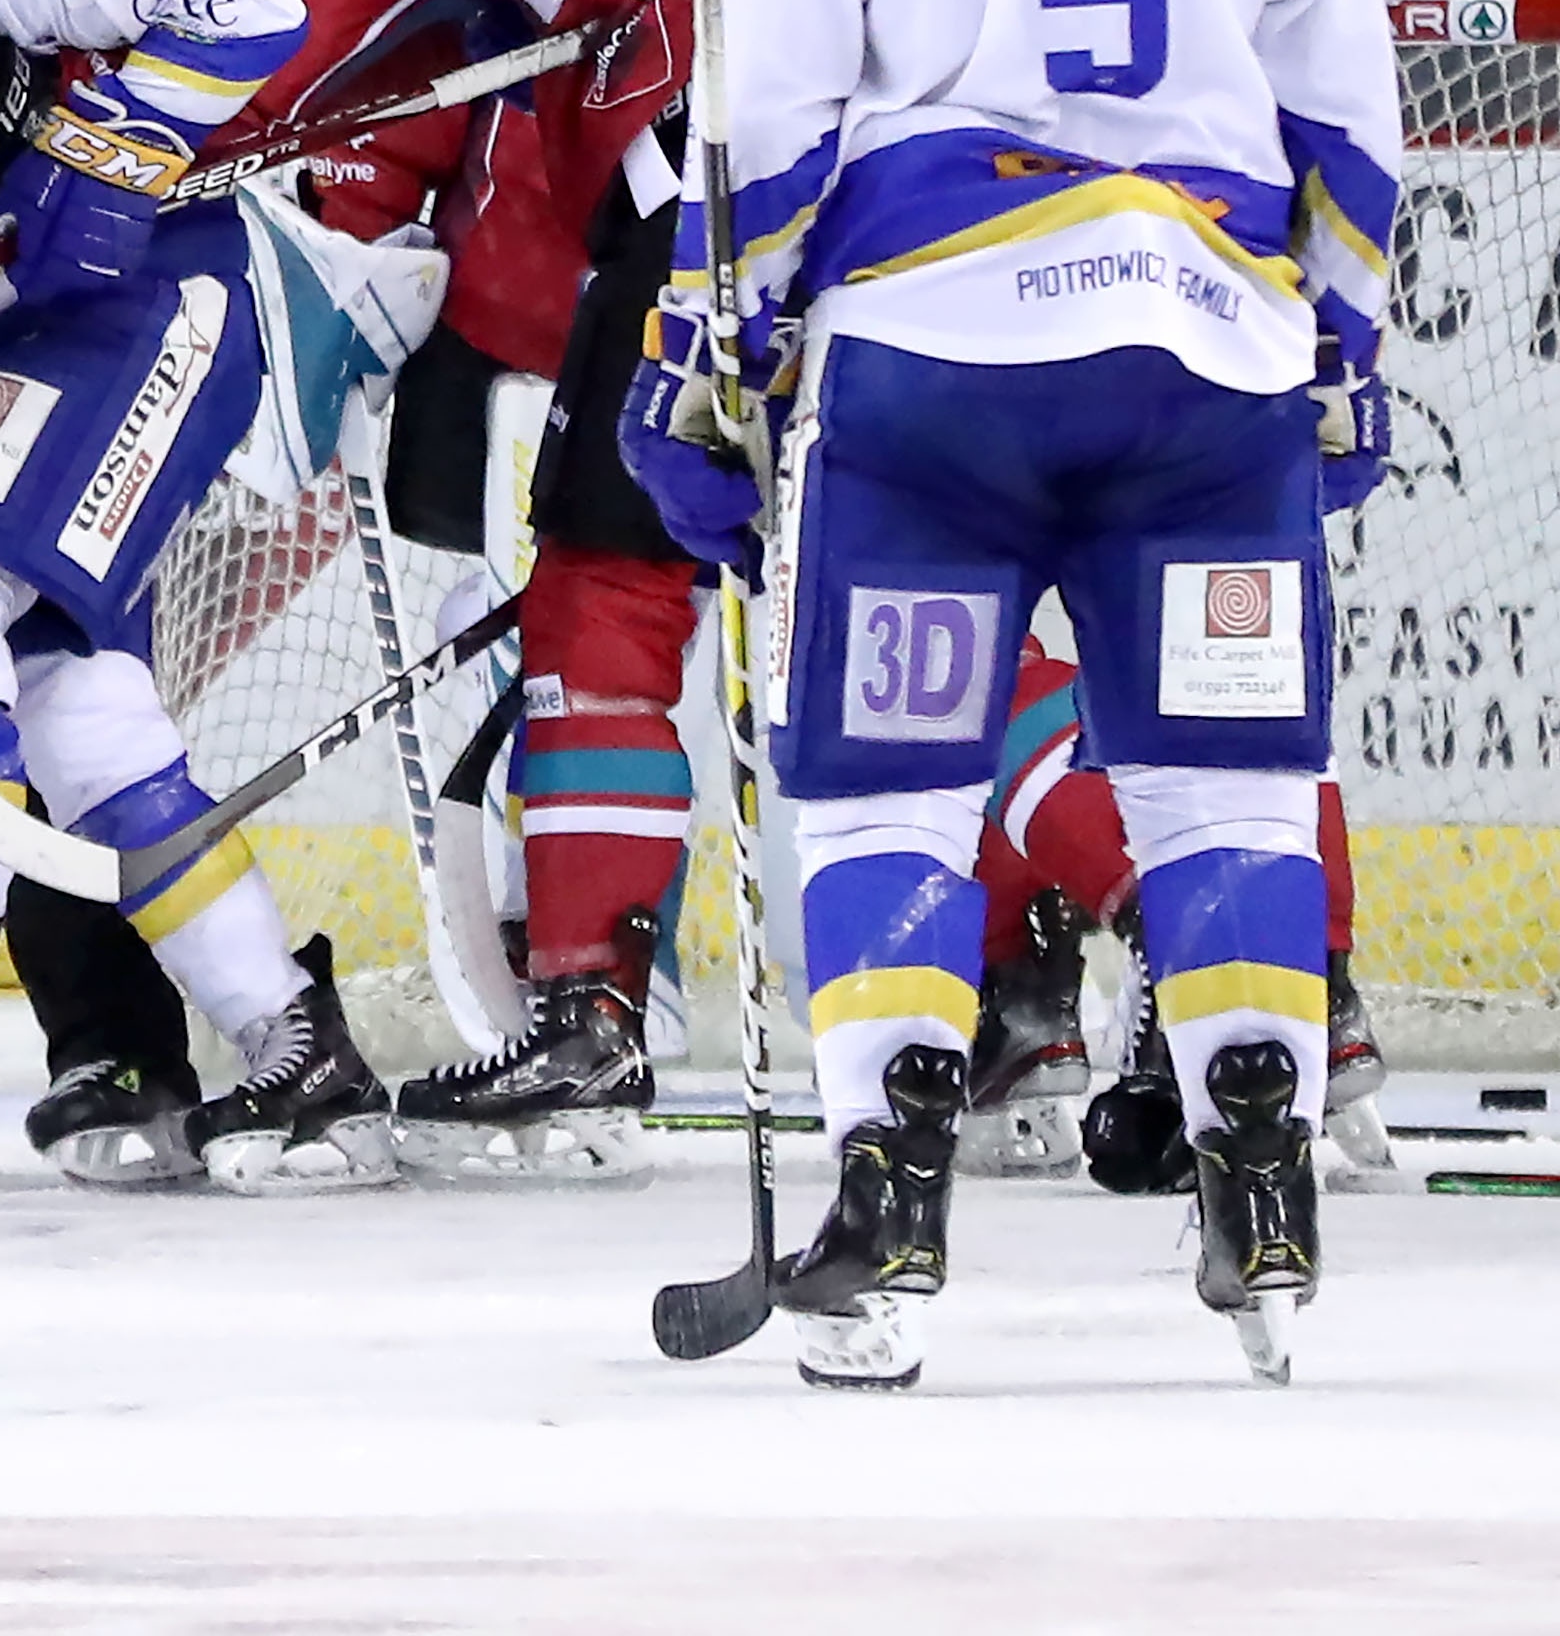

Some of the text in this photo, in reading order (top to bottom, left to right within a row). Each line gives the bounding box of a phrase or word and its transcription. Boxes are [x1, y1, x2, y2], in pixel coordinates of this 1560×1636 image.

[49, 121, 168, 188] CM
[73, 348, 181, 533] damson
[302, 640, 456, 772] CCM
[860, 598, 977, 718] 3D
